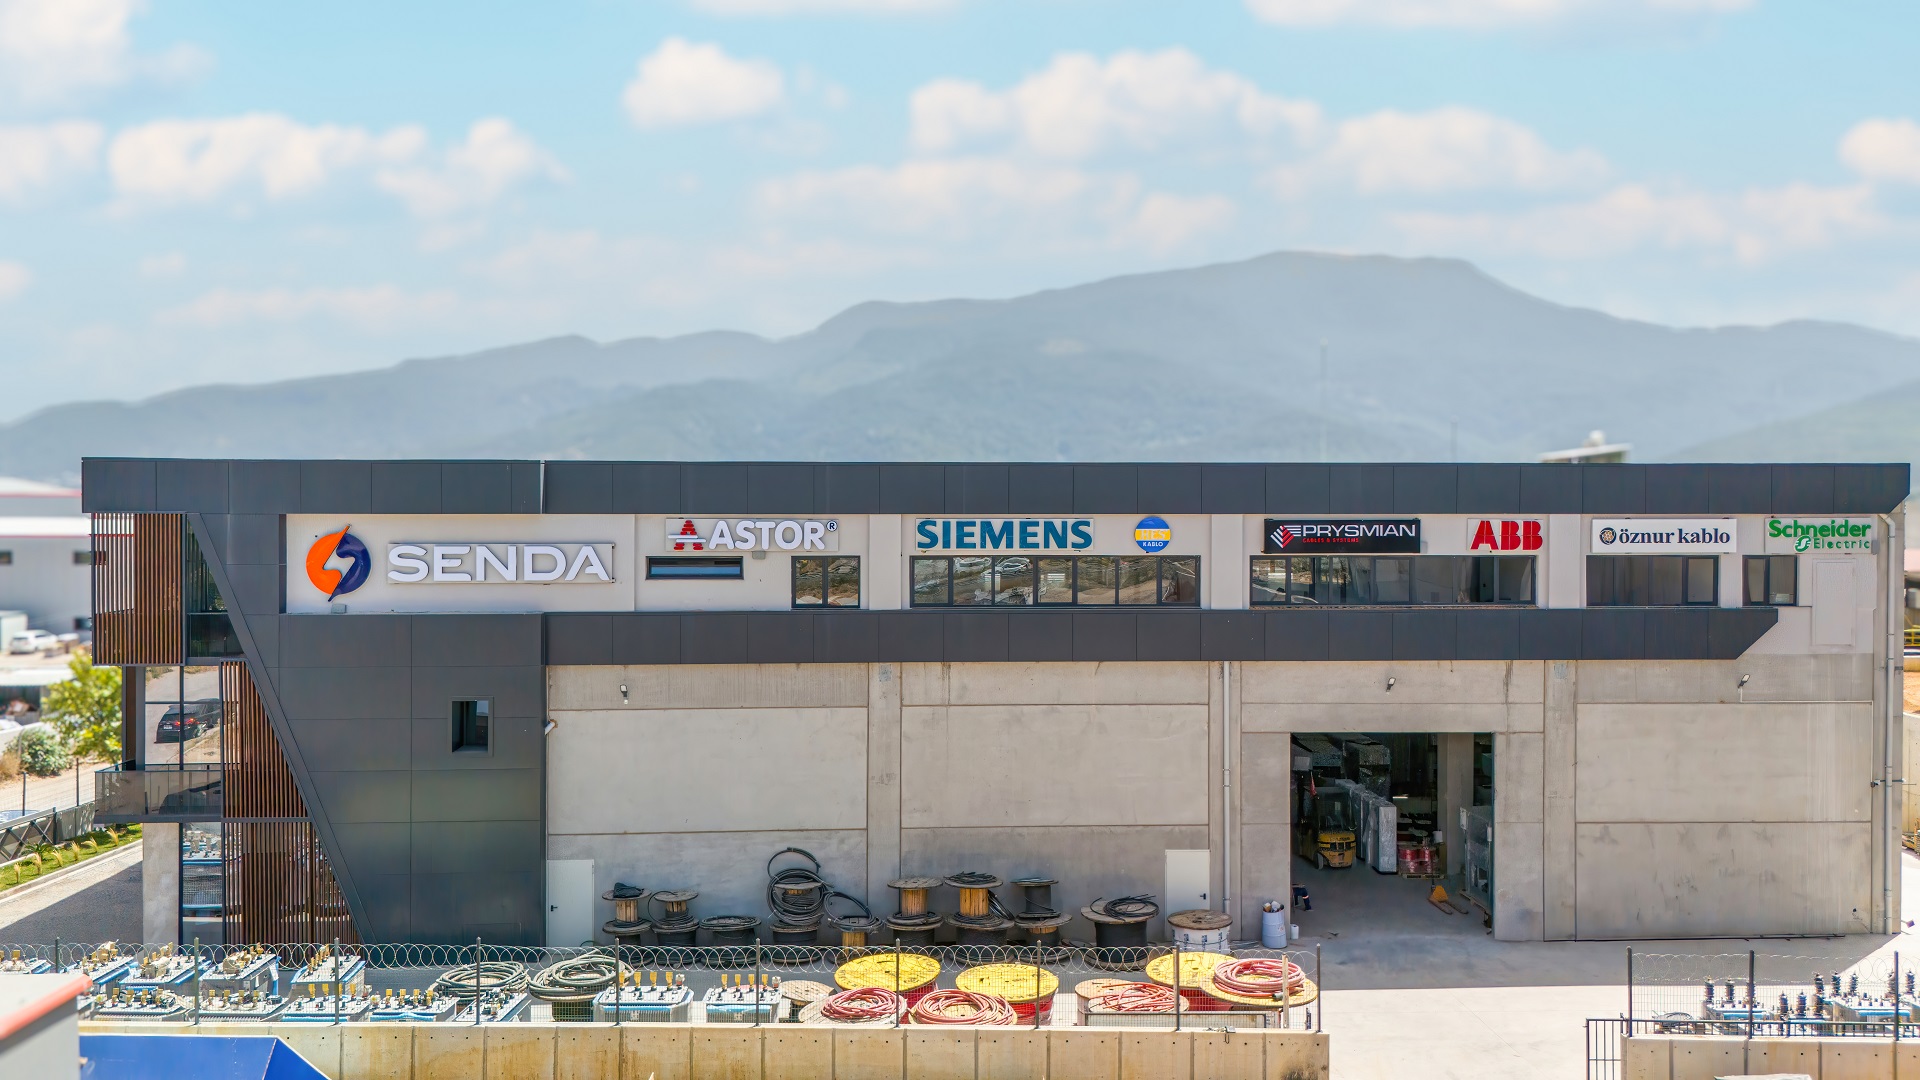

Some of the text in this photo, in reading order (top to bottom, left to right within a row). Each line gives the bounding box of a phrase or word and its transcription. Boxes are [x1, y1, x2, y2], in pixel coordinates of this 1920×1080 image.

[917, 520, 1093, 549] SIEMENS
[1302, 524, 1416, 537] PRYSMIAN
[1470, 520, 1543, 550] ABB
[1619, 528, 1730, 544] öznur kablo
[1768, 519, 1872, 537] Schneider
[1813, 537, 1870, 549] Electric
[388, 545, 611, 582] SENDA
